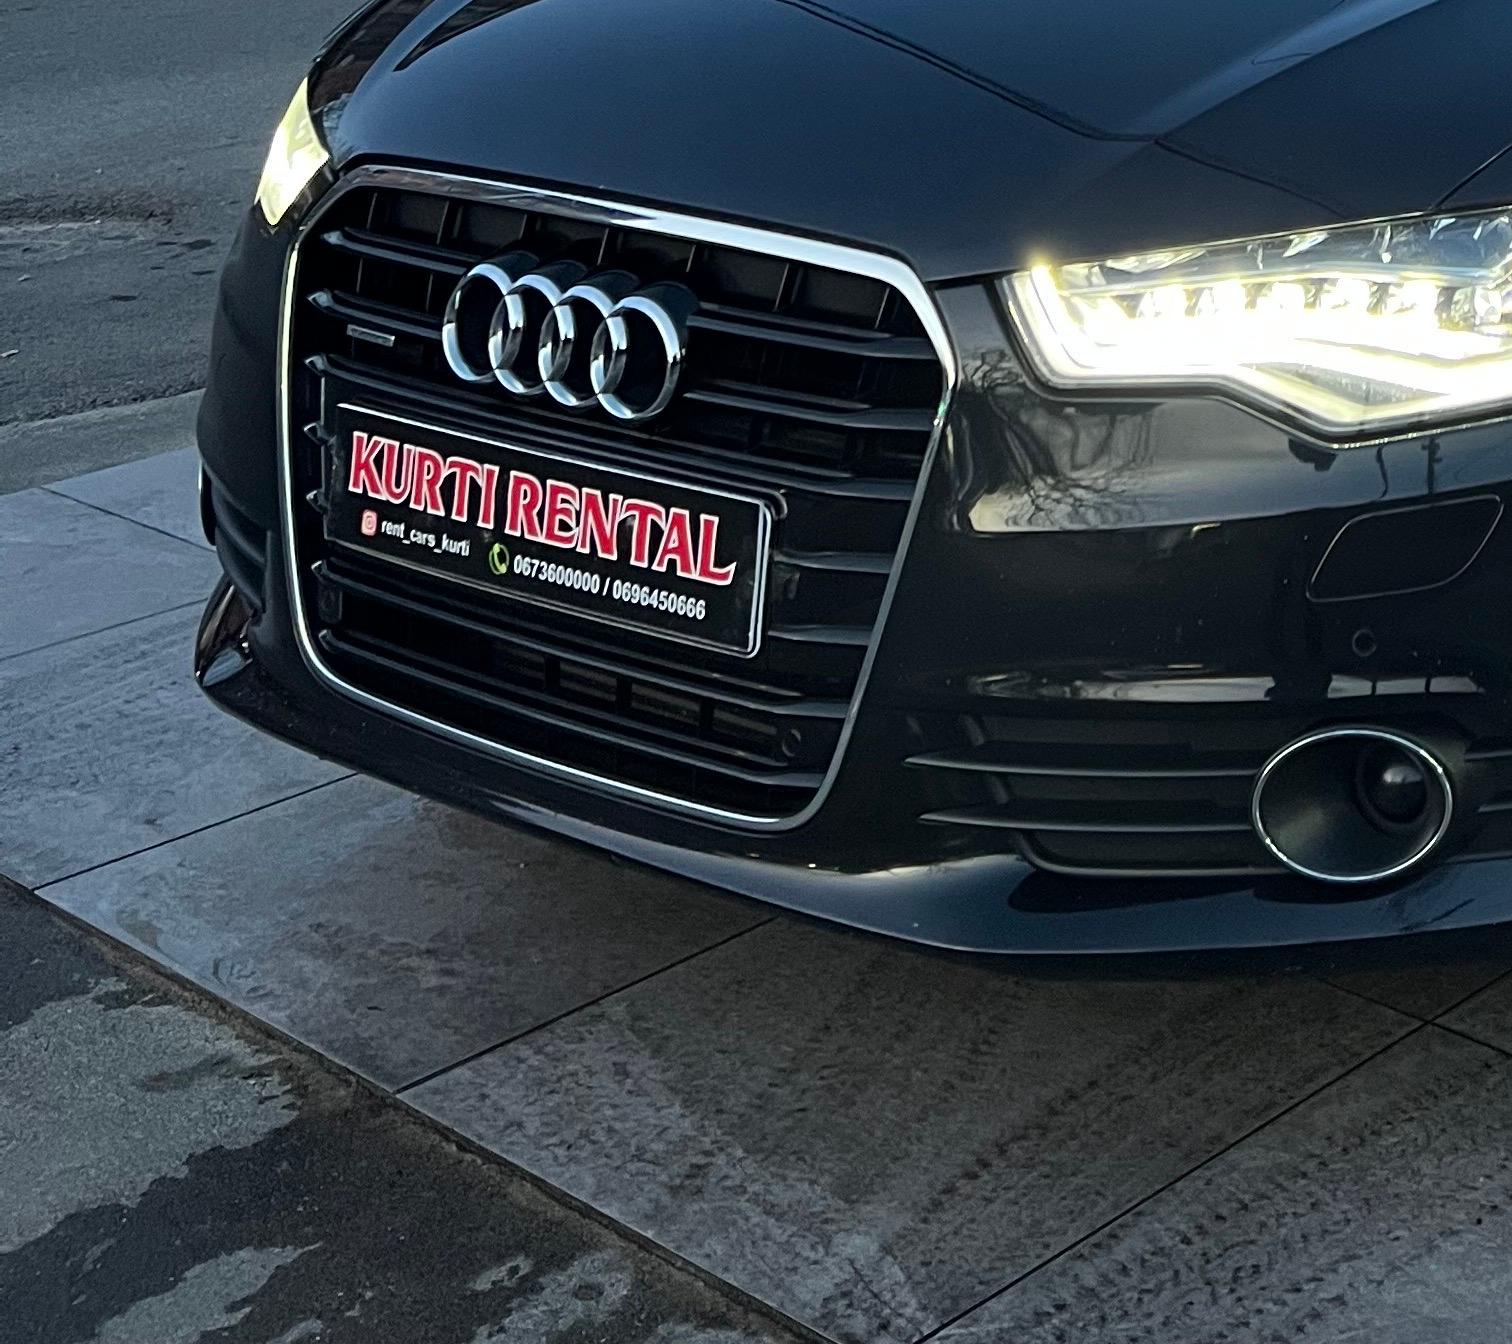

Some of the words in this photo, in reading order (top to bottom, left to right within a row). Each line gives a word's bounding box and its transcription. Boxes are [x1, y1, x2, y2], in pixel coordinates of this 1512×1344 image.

[348, 431, 500, 529] KURTI
[505, 470, 737, 586] RENTAL
[381, 520, 471, 557] rent_cars_kurti
[513, 554, 601, 594] 0673600000
[612, 579, 706, 620] 0696450666
